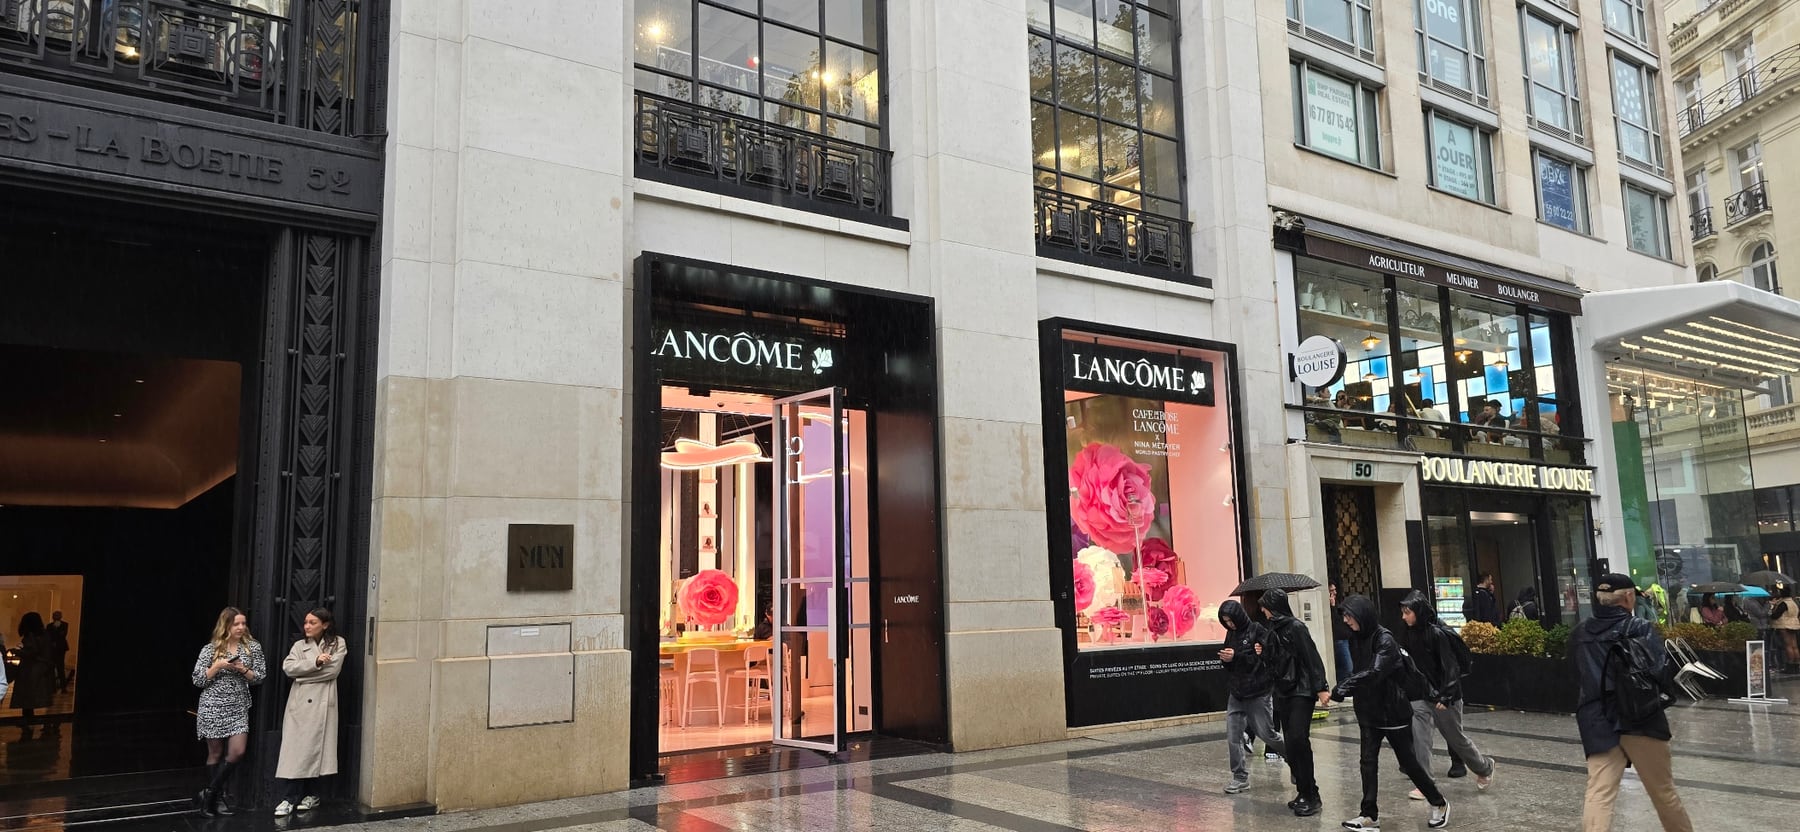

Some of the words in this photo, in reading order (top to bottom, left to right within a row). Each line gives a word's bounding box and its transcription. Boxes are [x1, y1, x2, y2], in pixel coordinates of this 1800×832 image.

[1426, 0, 1458, 23] one
[1316, 106, 1326, 123] 77
[1326, 110, 1336, 126] 87
[1336, 113, 1344, 130] 15
[1344, 116, 1354, 133] 42
[1447, 124, 1456, 145] À
[75, 126, 130, 159] LA
[141, 136, 283, 184] BOETIE
[306, 165, 350, 195] 52
[1368, 254, 1425, 277] AGRICULTEUR
[1446, 272, 1479, 290] MEUNIER
[1497, 284, 1540, 303] BOULANGER
[651, 328, 803, 371] ANCÔME
[1297, 350, 1335, 362] BOULANGERIE
[1073, 353, 1185, 392] LANCÔME
[1298, 358, 1336, 374] LOUISE
[1160, 410, 1179, 422] ROSE
[1133, 420, 1179, 435] LANCÔME
[1134, 440, 1150, 448] NINA
[1355, 463, 1372, 478] 50
[1421, 455, 1538, 488] BOULANGERIE
[1540, 466, 1594, 492] LOUISE
